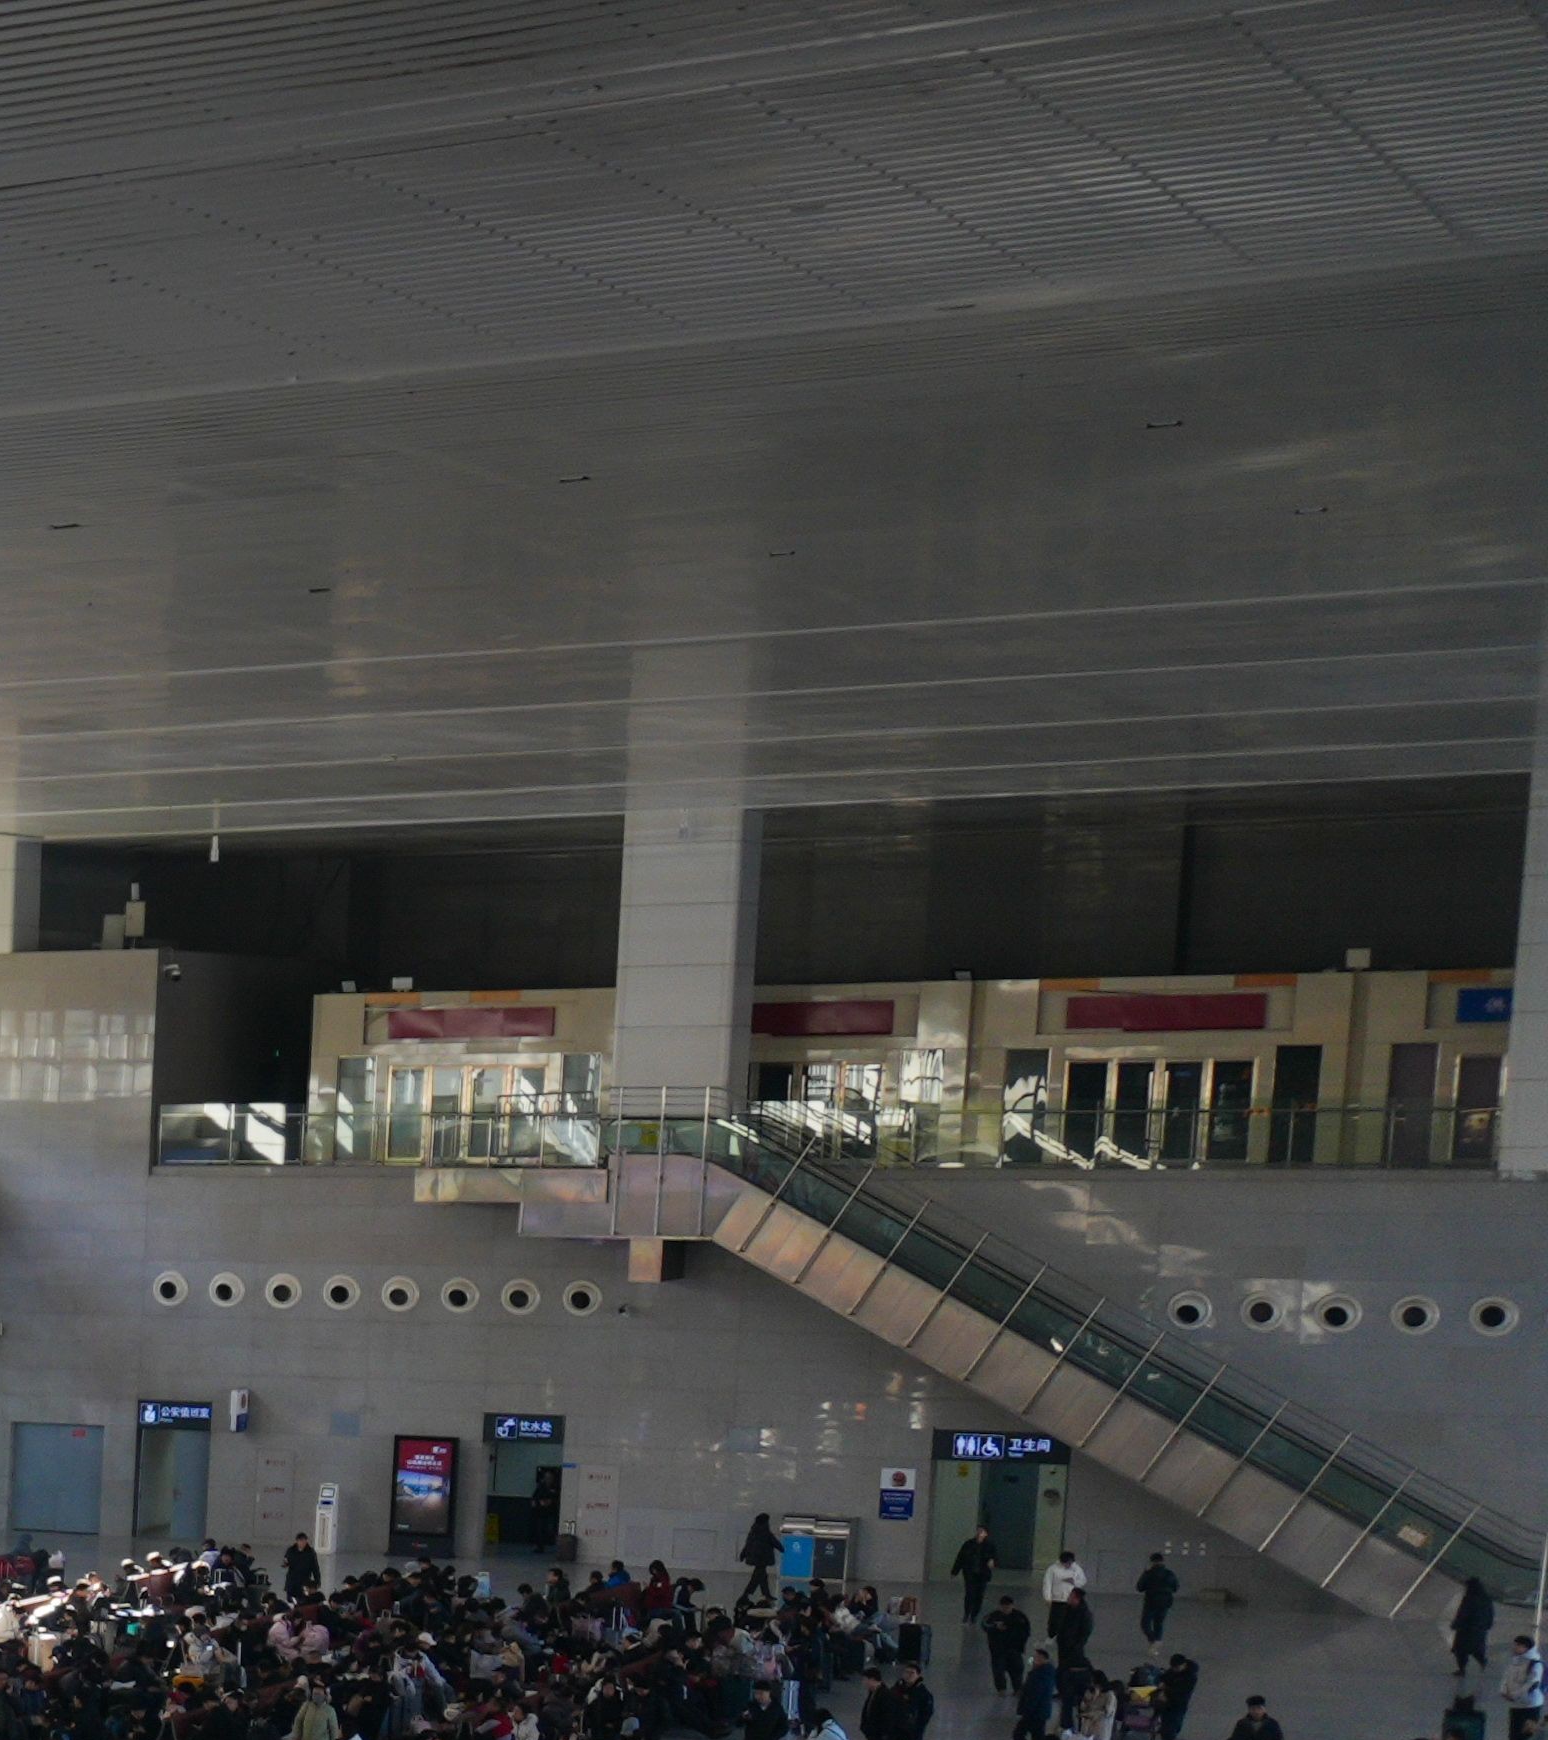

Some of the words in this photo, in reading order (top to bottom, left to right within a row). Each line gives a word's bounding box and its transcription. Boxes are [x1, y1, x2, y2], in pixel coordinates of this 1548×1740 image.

[520, 1420, 552, 1433] 饮水处
[1008, 1438, 1050, 1452] 卫生间
